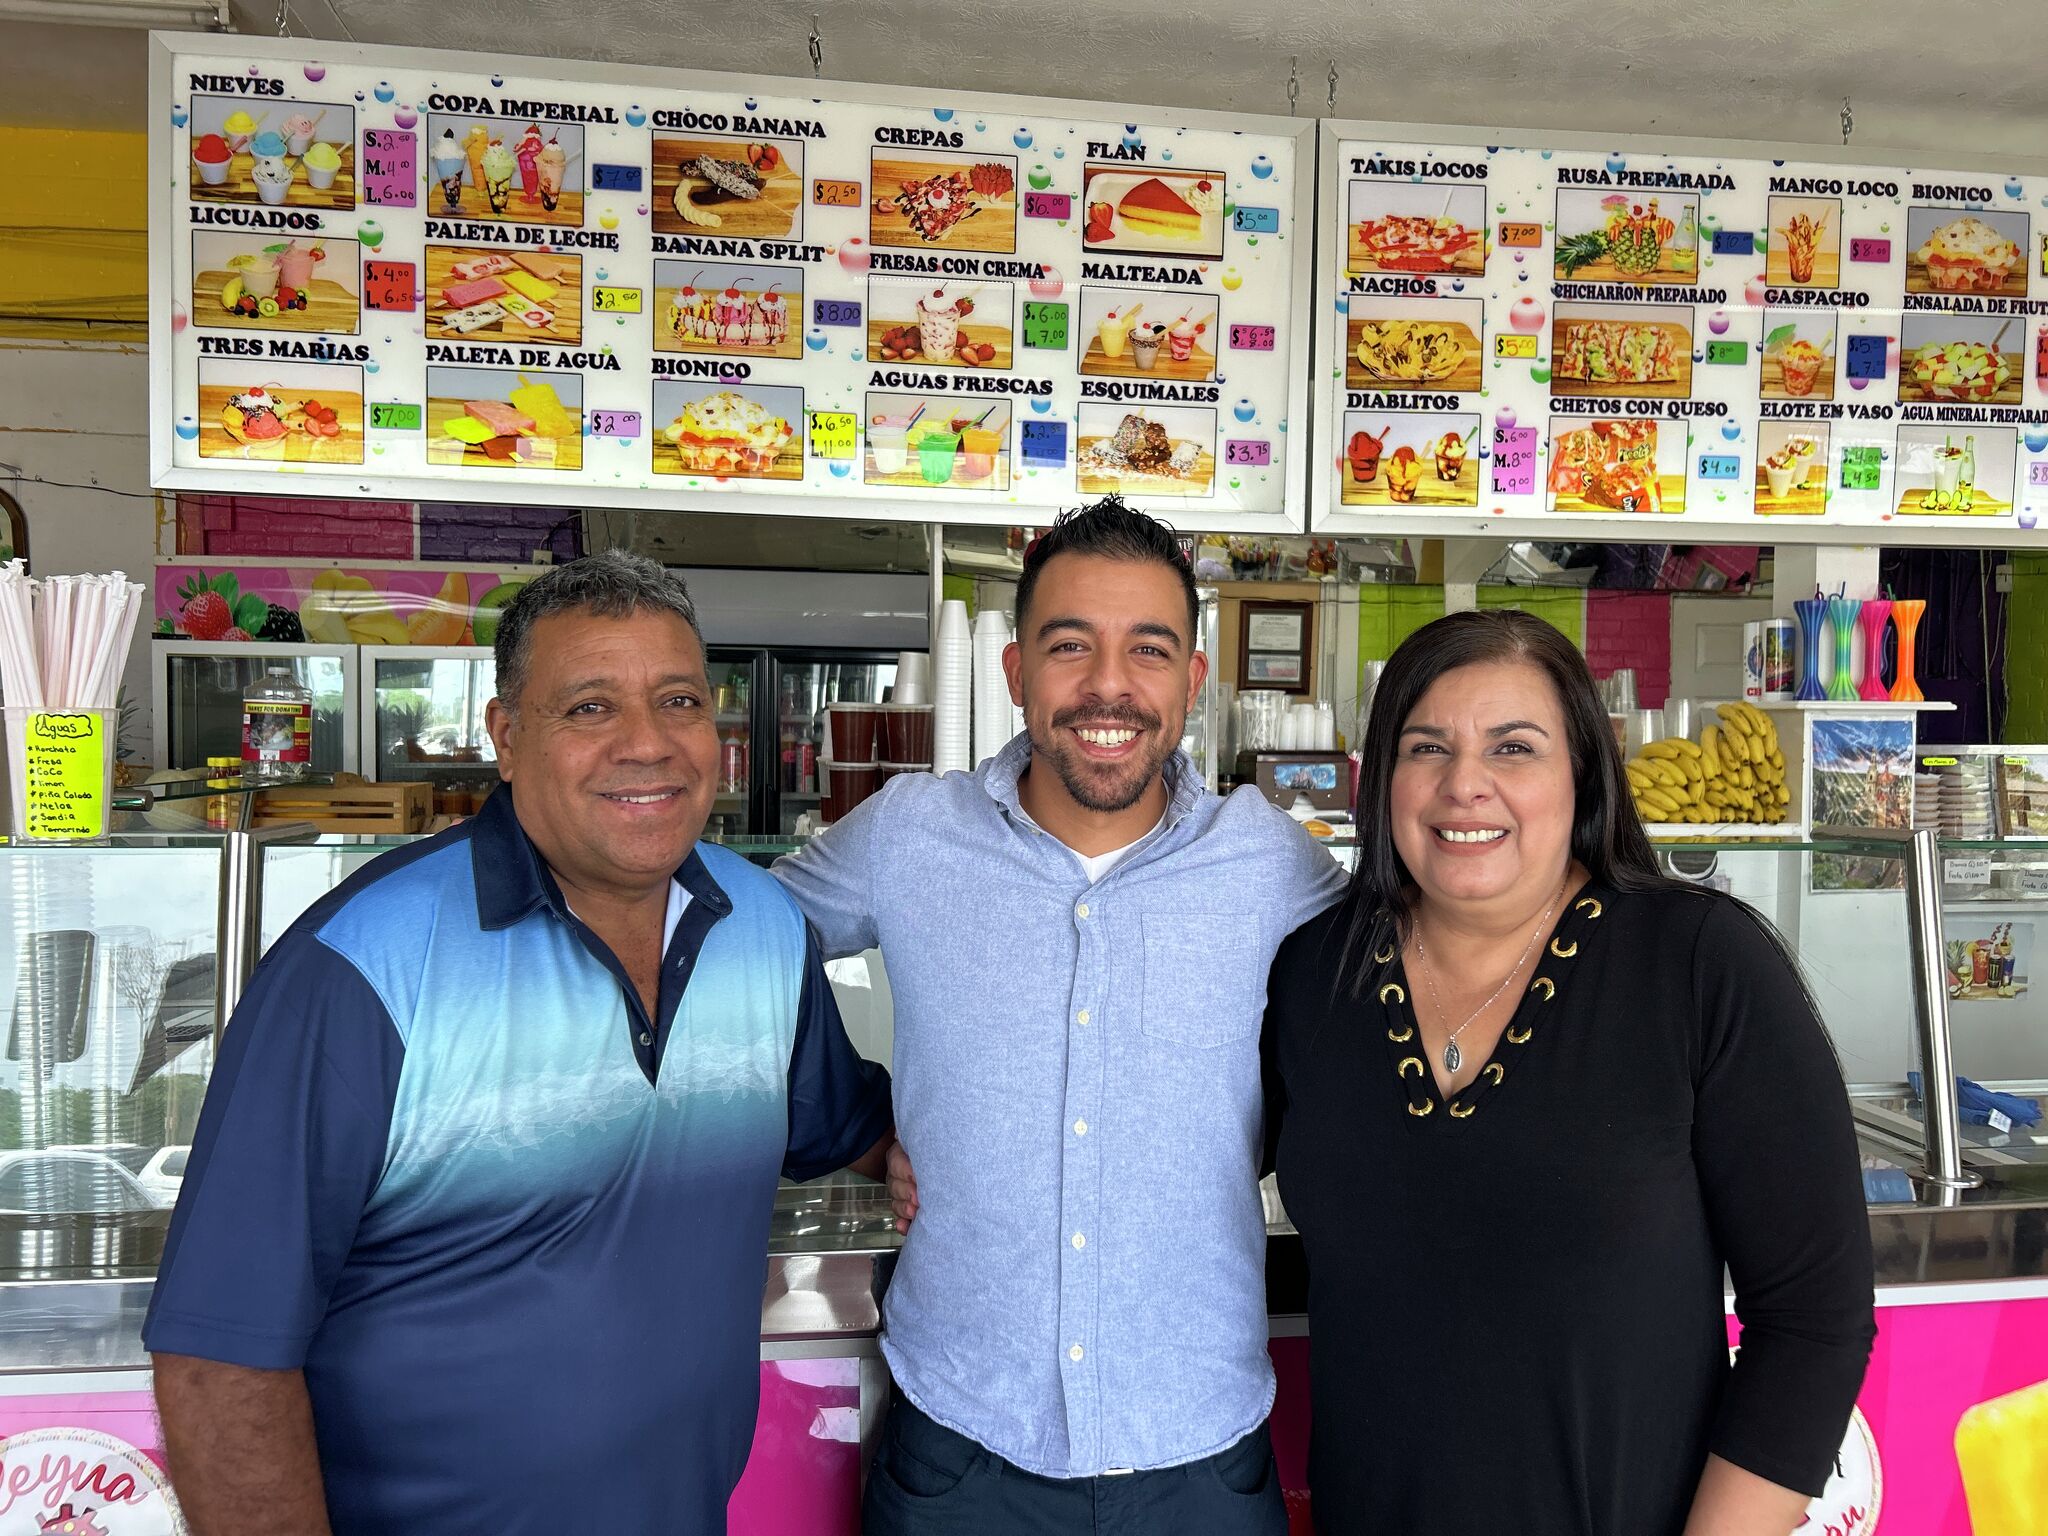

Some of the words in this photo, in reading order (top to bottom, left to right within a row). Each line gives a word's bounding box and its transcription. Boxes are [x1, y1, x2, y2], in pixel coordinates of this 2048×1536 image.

[190, 74, 284, 95] NIEVES
[428, 94, 495, 115] COPA
[500, 99, 619, 124] IMPERIAL
[652, 110, 728, 131] CHOCO
[733, 116, 826, 138] BANANA
[874, 127, 964, 147] CREPAS
[1086, 142, 1146, 161] FLAN
[1350, 159, 1415, 176] TAKIS
[1420, 162, 1488, 179] LOCOS
[1558, 168, 1612, 185] RUSA
[1617, 171, 1736, 190] PREPARADA
[1769, 177, 1843, 194] MANGO
[1847, 181, 1899, 197] LOCO
[1912, 184, 1992, 202] BIONICO
[190, 207, 320, 230] LICUADOS
[424, 222, 510, 243] PALETA
[515, 227, 544, 244] DE
[550, 229, 619, 249] LECHE
[651, 237, 755, 258] BANANA
[760, 243, 825, 262] SPLIT
[869, 253, 938, 273] FRESAS
[942, 258, 979, 276] CON
[983, 261, 1045, 279] CREMA
[1081, 263, 1203, 285] MALTEADA
[1349, 277, 1436, 294] NACHOS
[1647, 287, 1727, 304] PREPARADO
[1764, 289, 1870, 306] GASPACHO
[1903, 295, 1984, 312] ENSALADA
[1984, 299, 2007, 313] DE
[2010, 300, 2048, 315] FRUT
[198, 337, 263, 356] TRES
[269, 340, 369, 361] MARIAS
[425, 345, 514, 365] PALETA
[519, 350, 551, 366] DE
[555, 352, 621, 371] AGUA
[651, 358, 751, 379] BIONICO
[869, 370, 948, 390] AGUAS
[953, 375, 1053, 395] FRESCAS
[1081, 381, 1219, 402] ESQUIMALES
[1346, 393, 1459, 410] DIABLITOS
[1550, 398, 1621, 414] CHETOS
[1625, 401, 1663, 415] CON
[1667, 402, 1728, 419] QUESO
[1760, 403, 1815, 418] ELOTE
[1819, 404, 1843, 419] EN
[1847, 405, 1893, 419] VASO
[1901, 406, 1934, 421] AGUA
[1936, 407, 1988, 422] MINERAL
[39, 716, 77, 739] Aguas
